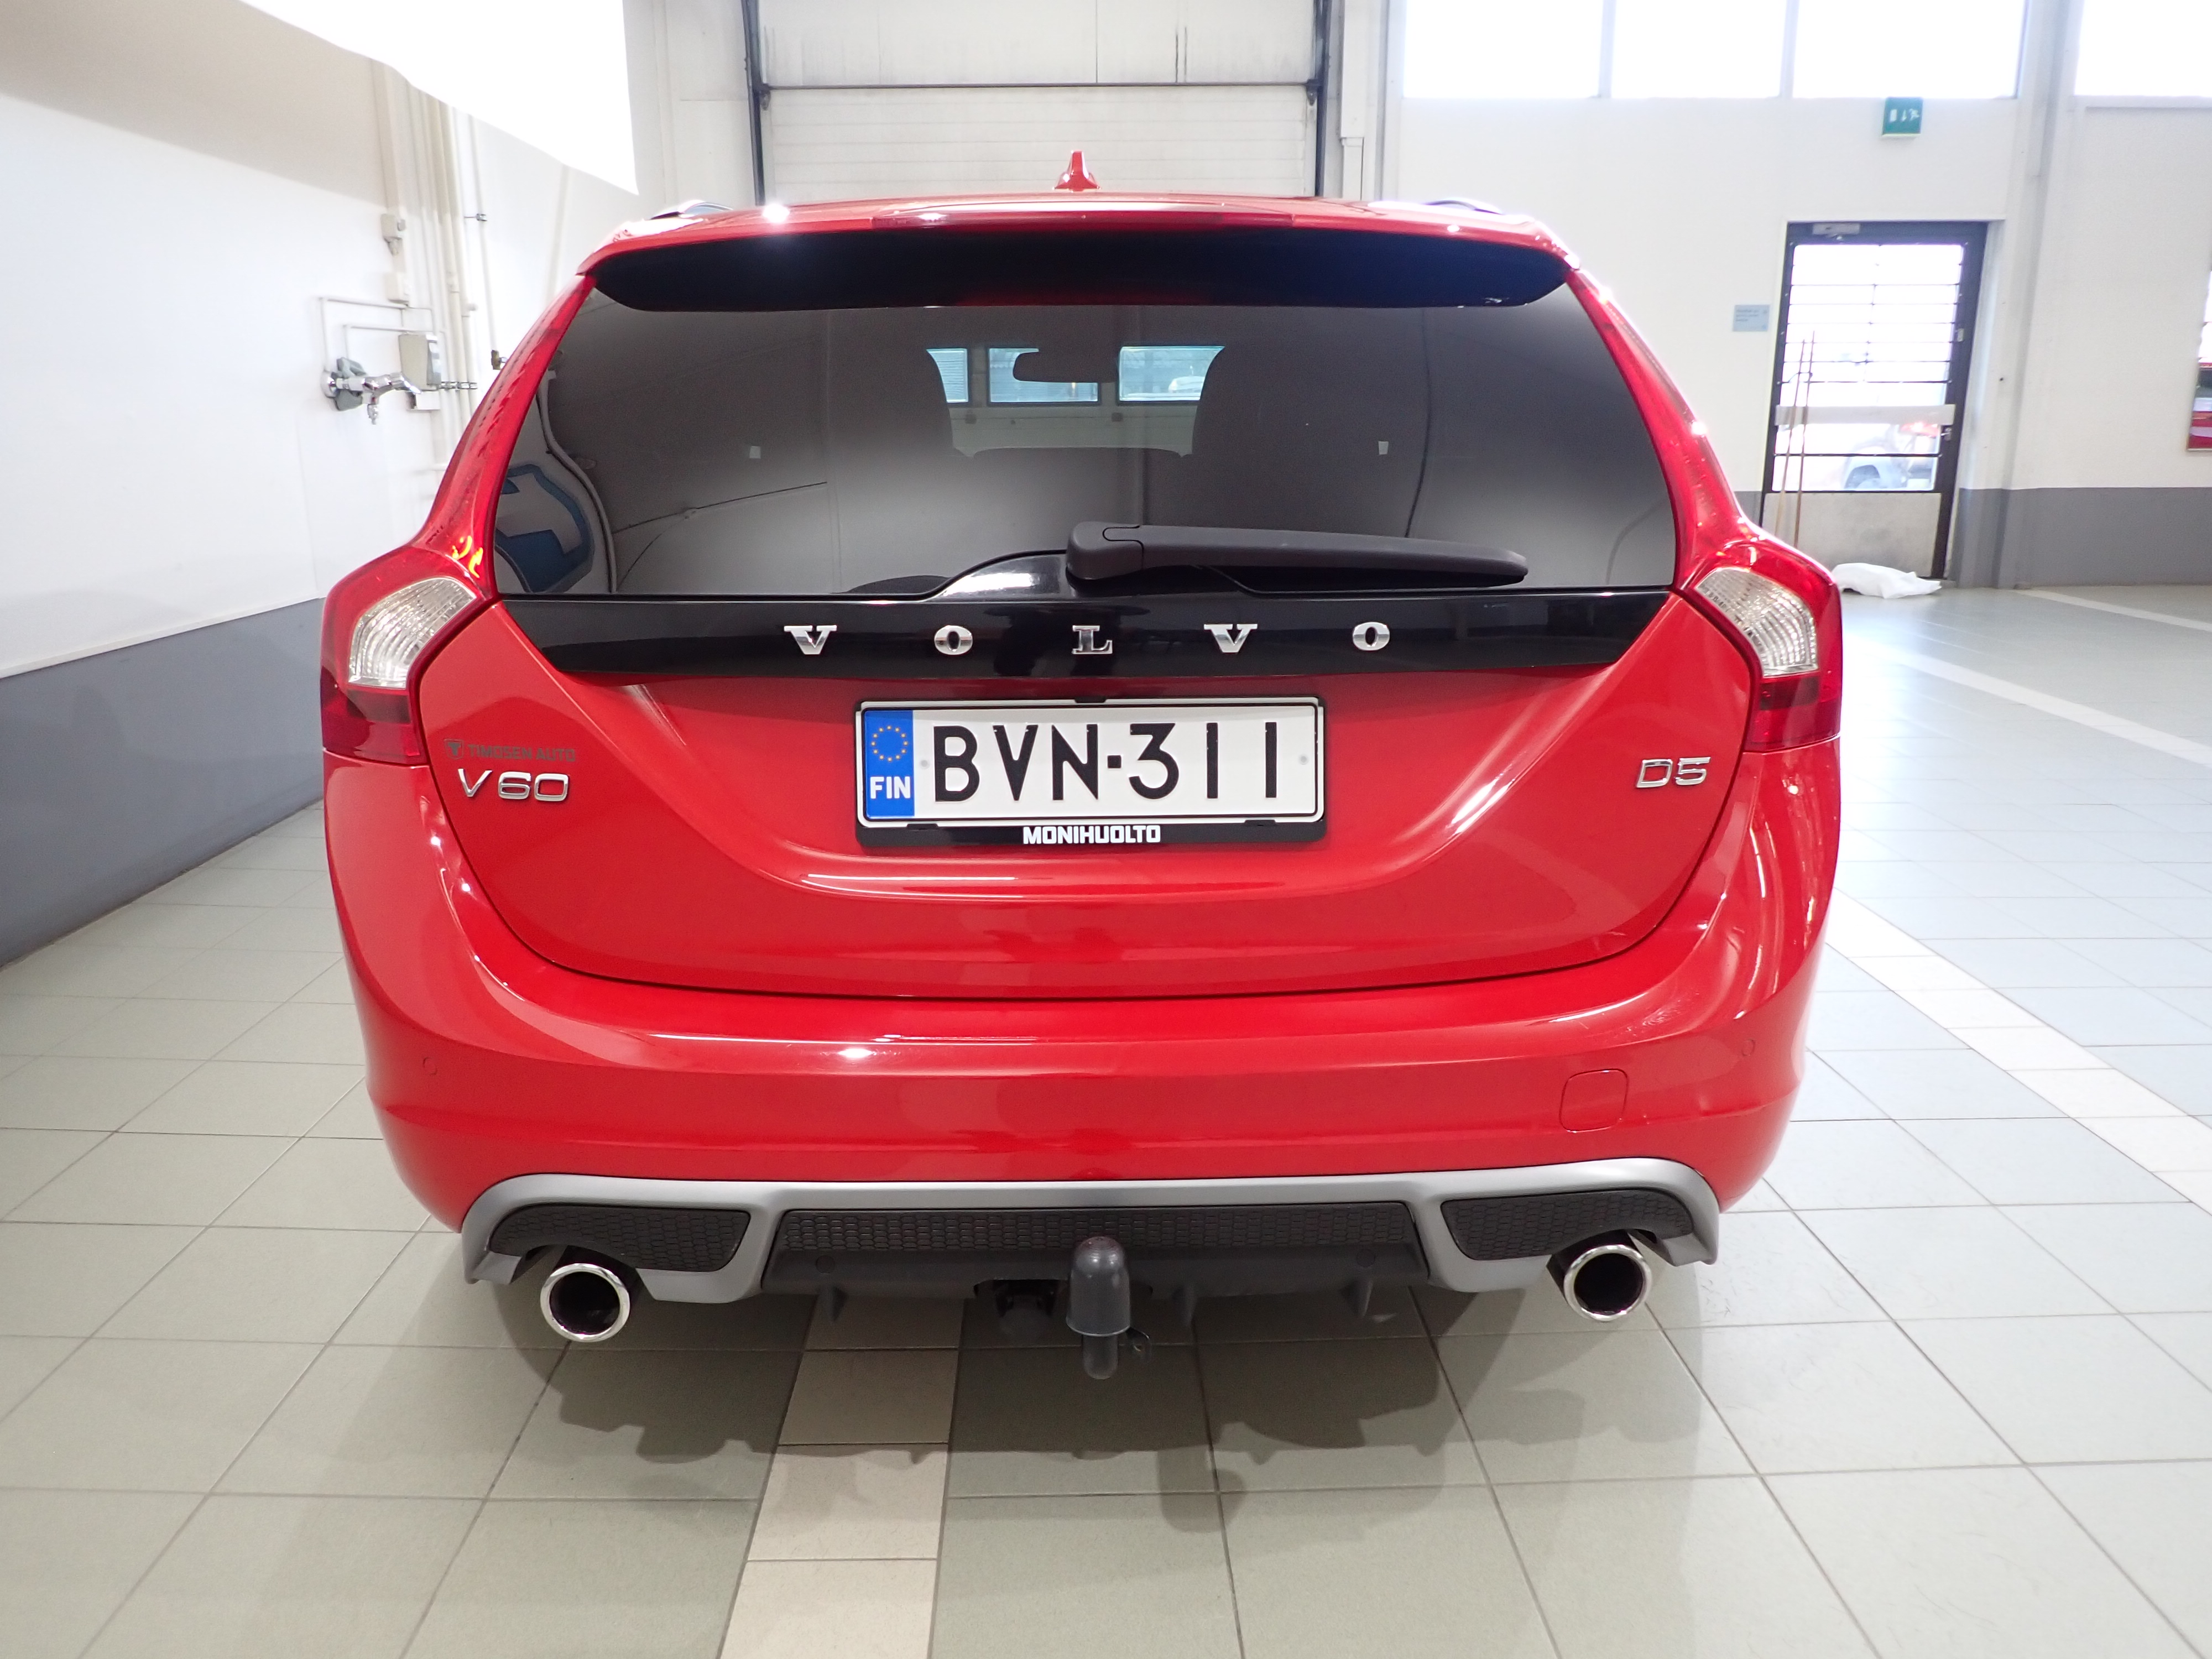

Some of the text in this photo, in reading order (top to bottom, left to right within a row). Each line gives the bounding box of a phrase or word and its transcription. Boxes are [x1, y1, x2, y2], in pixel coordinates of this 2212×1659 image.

[783, 622, 1391, 655] VOLVO
[467, 744, 533, 760] TIMOSEN
[535, 748, 576, 763] AUTO
[933, 722, 1277, 802] BVN-311
[457, 768, 569, 802] V60
[870, 776, 911, 799] FIN
[1636, 756, 1712, 789] D5
[1022, 825, 1161, 844] MONIHUOLTO
